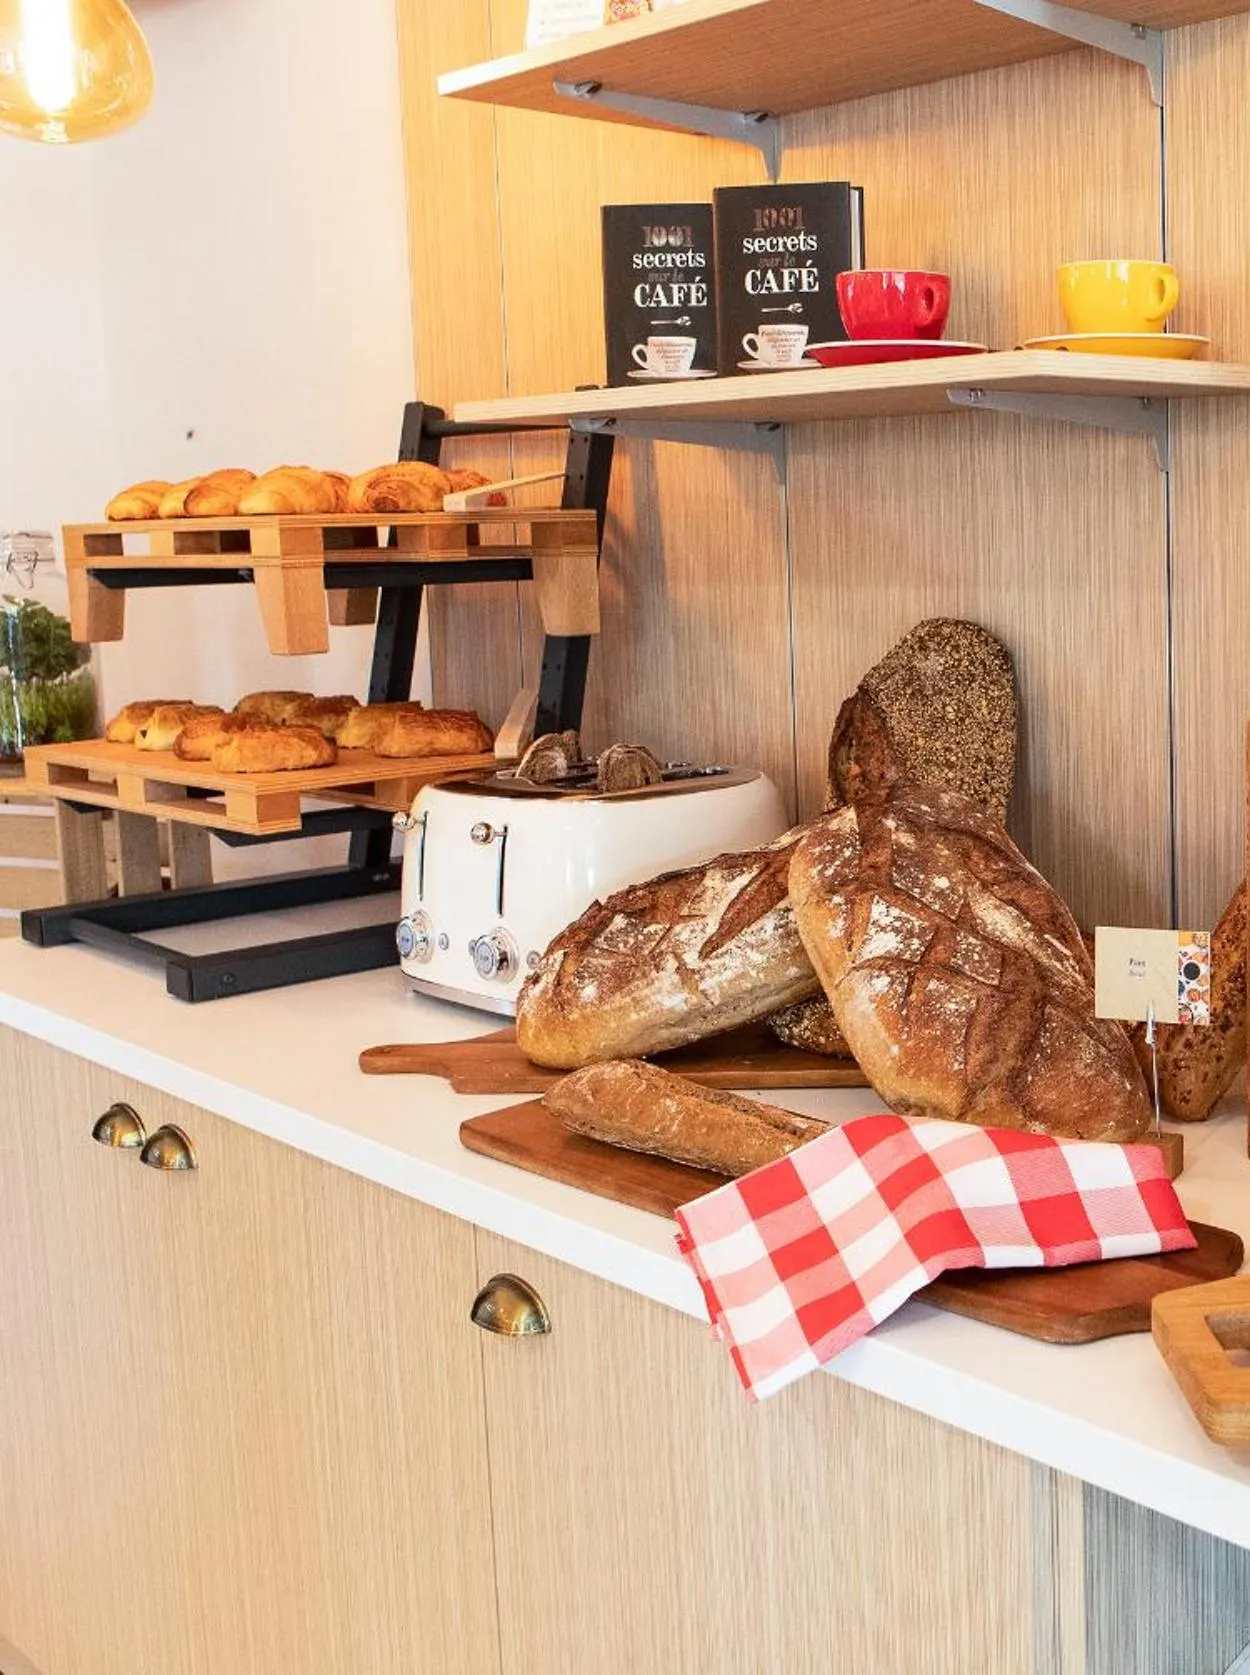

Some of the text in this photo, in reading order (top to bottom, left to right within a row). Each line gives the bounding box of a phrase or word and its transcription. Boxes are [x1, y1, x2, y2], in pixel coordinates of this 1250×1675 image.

[742, 231, 818, 254] secrets
[632, 248, 706, 269] secrets
[744, 260, 819, 294] CAFÉ
[633, 276, 708, 308] CAFÉ
